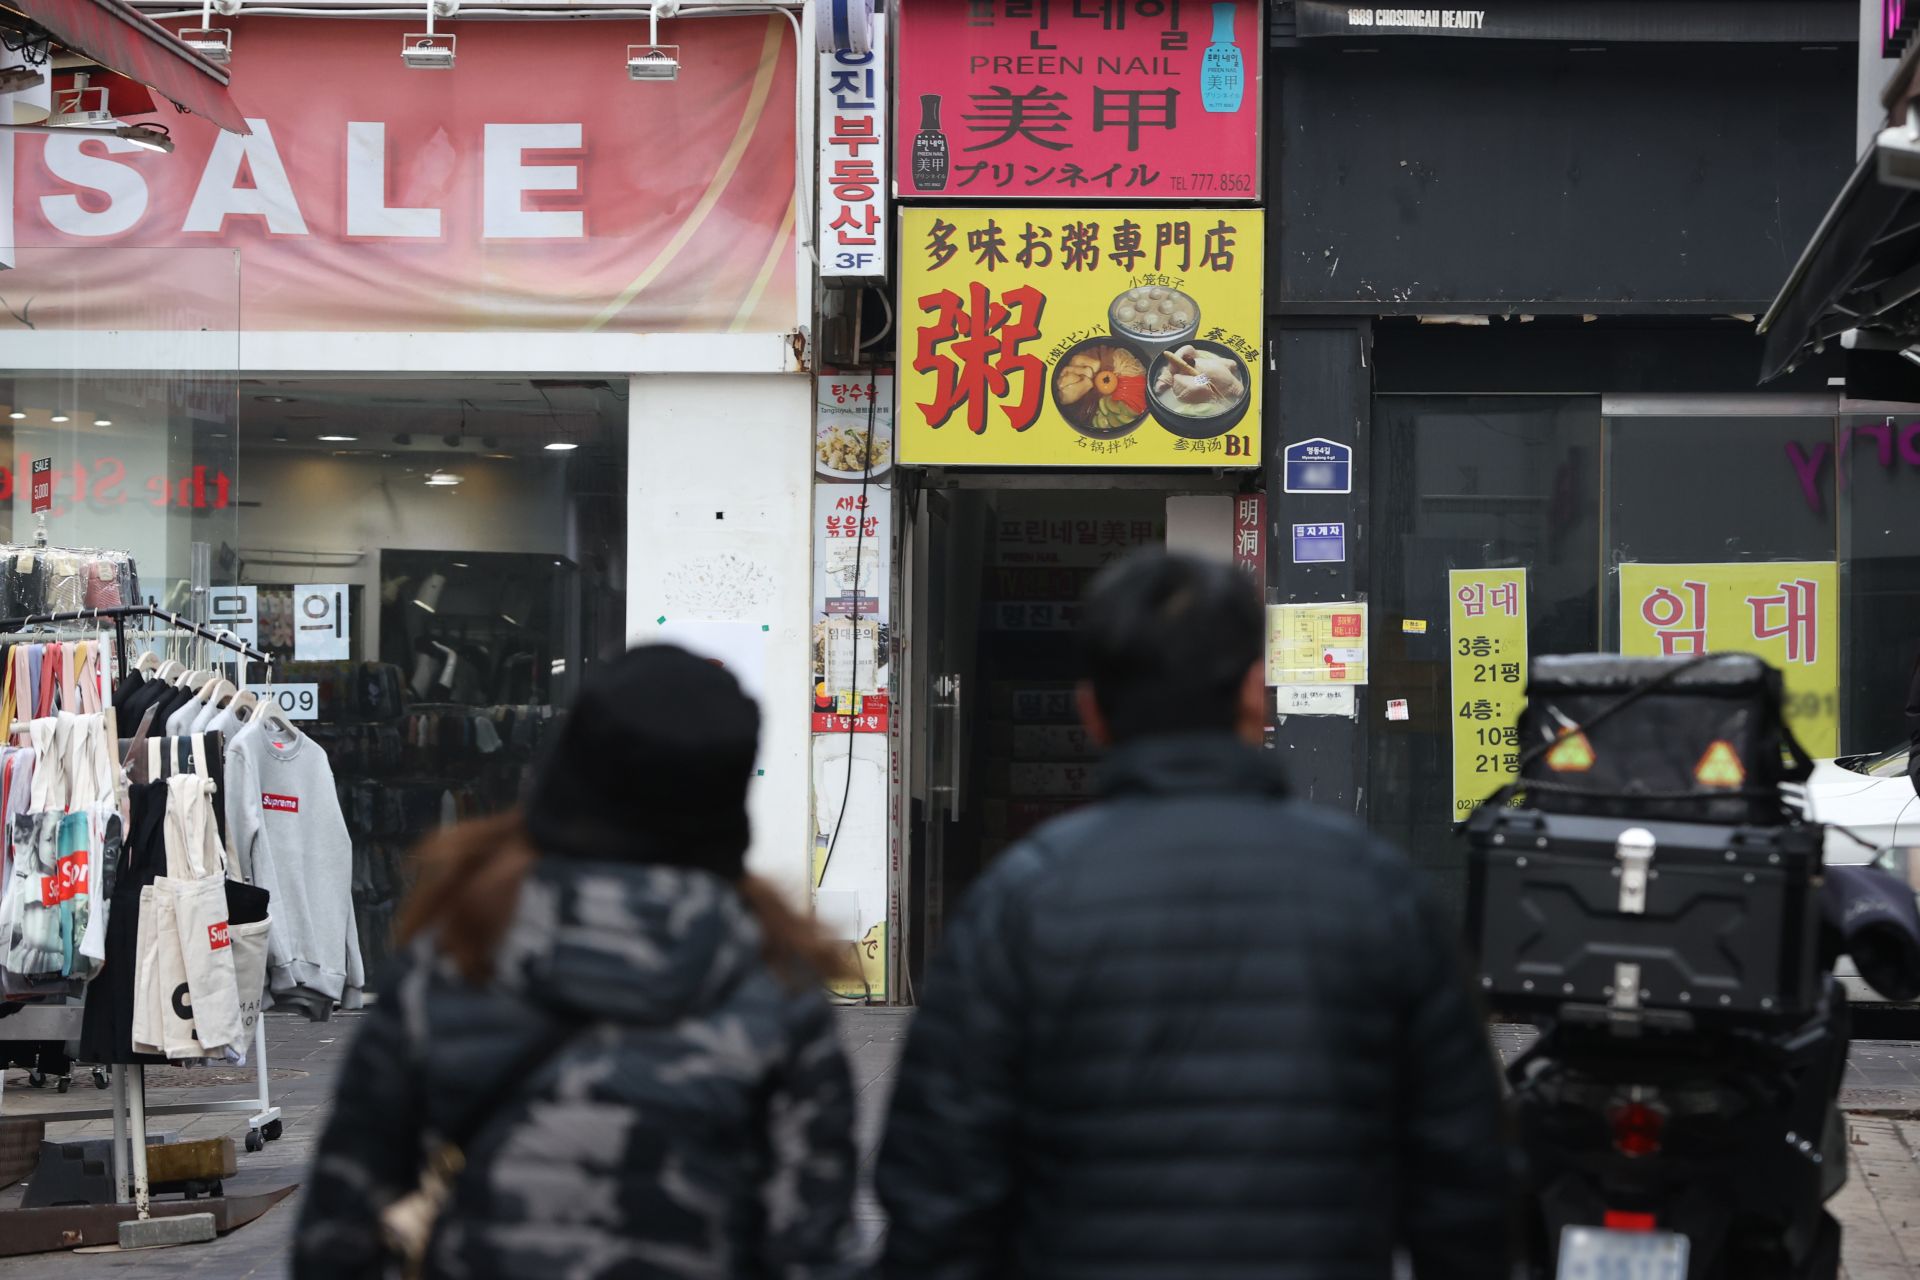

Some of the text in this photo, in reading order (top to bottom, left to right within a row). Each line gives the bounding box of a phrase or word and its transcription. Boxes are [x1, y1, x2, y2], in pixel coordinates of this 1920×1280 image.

[1347, 9, 1485, 29] 1989 CHOSUNGAH BEAUTY
[970, 56, 1180, 75] PREEN NAIL
[1207, 74, 1238, 91] 美甲
[960, 85, 1181, 152] 美甲
[917, 158, 944, 172] 美甲
[954, 161, 1160, 188] プリンネイル
[39, 118, 585, 238] SALE
[1170, 176, 1188, 191] TEL
[925, 218, 1237, 273] 多味お粥専門店
[835, 253, 873, 269] 3F
[912, 281, 1047, 435] 粥
[1224, 434, 1251, 457] B1
[34, 459, 49, 472] SALE
[1457, 582, 1520, 617] 임대
[1458, 636, 1500, 657] 3층:
[1473, 662, 1520, 683] 21평
[1459, 699, 1501, 721] 4층:
[1476, 726, 1520, 746] 10평
[1475, 753, 1521, 774] 21평
[263, 795, 296, 808] Supreme
